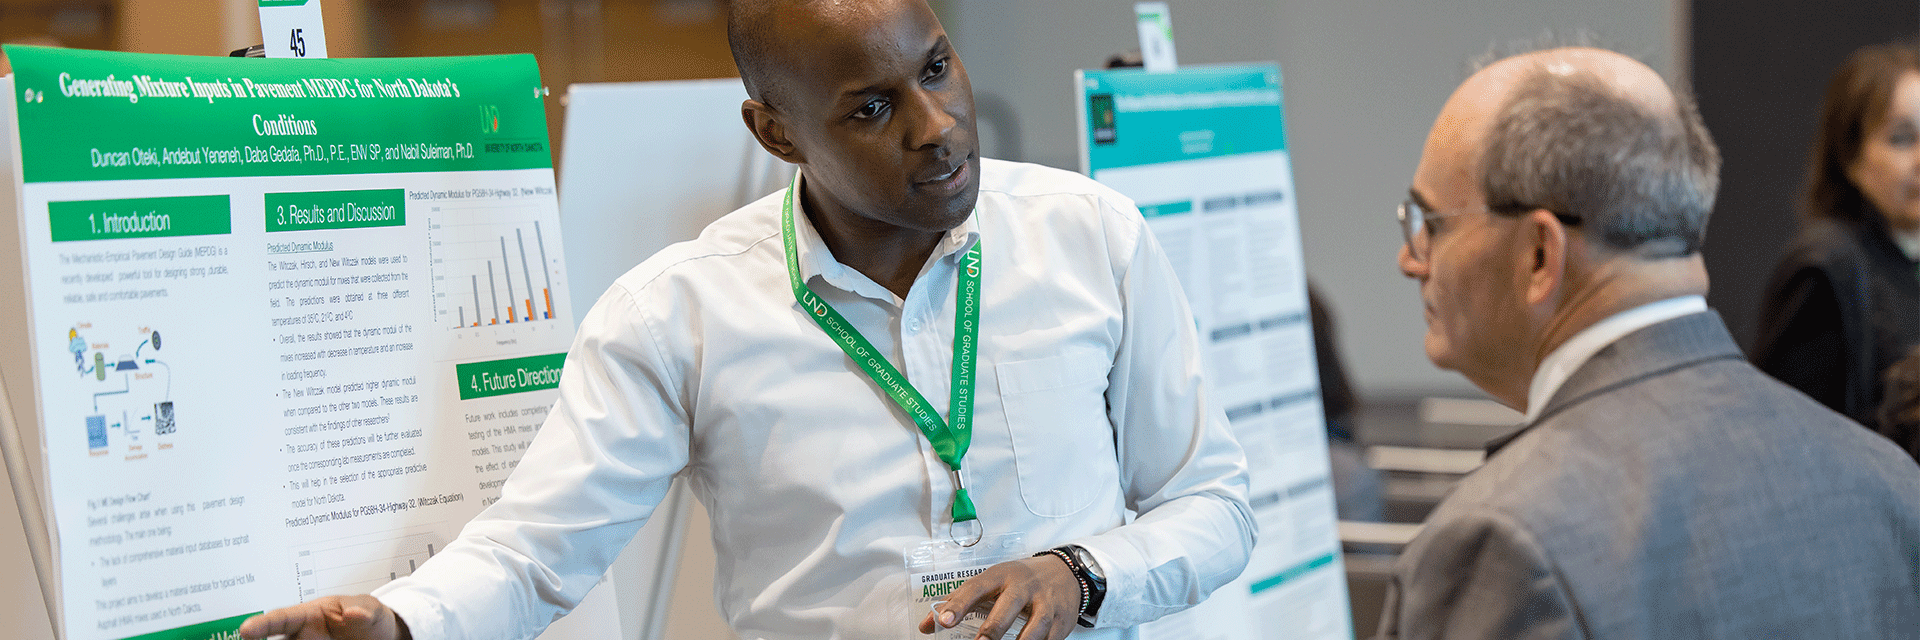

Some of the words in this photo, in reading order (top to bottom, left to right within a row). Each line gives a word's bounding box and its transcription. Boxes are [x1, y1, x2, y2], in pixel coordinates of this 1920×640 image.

[290, 29, 305, 57] 45
[59, 72, 138, 103] Generating
[133, 75, 190, 97] Mixture
[186, 76, 232, 104] Inputs
[229, 78, 246, 98] in
[242, 78, 306, 98] Pavement
[302, 78, 356, 98] MEPDG
[354, 78, 373, 98] for
[372, 78, 407, 98] North
[253, 114, 317, 136] Conditions
[479, 105, 500, 134] UND
[91, 148, 130, 167] Duncan
[132, 147, 160, 167] Oteki,
[162, 147, 201, 165] Andebut
[202, 147, 243, 165] Yeneneh,
[245, 146, 268, 162] Daba
[270, 145, 302, 163] Gedafa,
[304, 145, 329, 163] Ph.D.,
[330, 144, 350, 162] P.E.,
[351, 144, 368, 160] ENV
[385, 144, 399, 160] and
[401, 143, 419, 160] Nabil
[420, 143, 454, 161] Suleiman,
[456, 142, 474, 159] Ph.D.
[89, 213, 101, 233] 1.
[103, 211, 170, 233] Introduction
[277, 206, 286, 225] 3.
[290, 204, 324, 224] Results
[327, 203, 344, 222] and
[347, 202, 395, 221] Discussion
[267, 243, 290, 252] Predicted
[292, 242, 312, 252] Dynamic
[313, 241, 333, 250] Modulus
[967, 251, 979, 277] UND
[964, 280, 974, 318] SCHOOL
[964, 320, 972, 333] OF
[803, 291, 827, 317] UND
[826, 317, 857, 349] SCHOOL
[856, 346, 870, 361] OF
[868, 358, 908, 399] GRADUATE
[906, 397, 936, 432] STUDIES
[960, 335, 971, 385] GRADUATE
[471, 375, 481, 392] 4.
[482, 372, 516, 391] Future
[517, 365, 564, 387] Direction
[957, 388, 968, 430] STUDIES
[479, 478, 508, 490] developme
[285, 515, 309, 527] Predicted
[309, 512, 330, 526] Dynamic
[331, 509, 352, 520] Modulus
[408, 499, 416, 509] 32.
[418, 496, 438, 508] (Witczak
[439, 492, 464, 505] Equation)
[922, 572, 954, 583] GRADUATE
